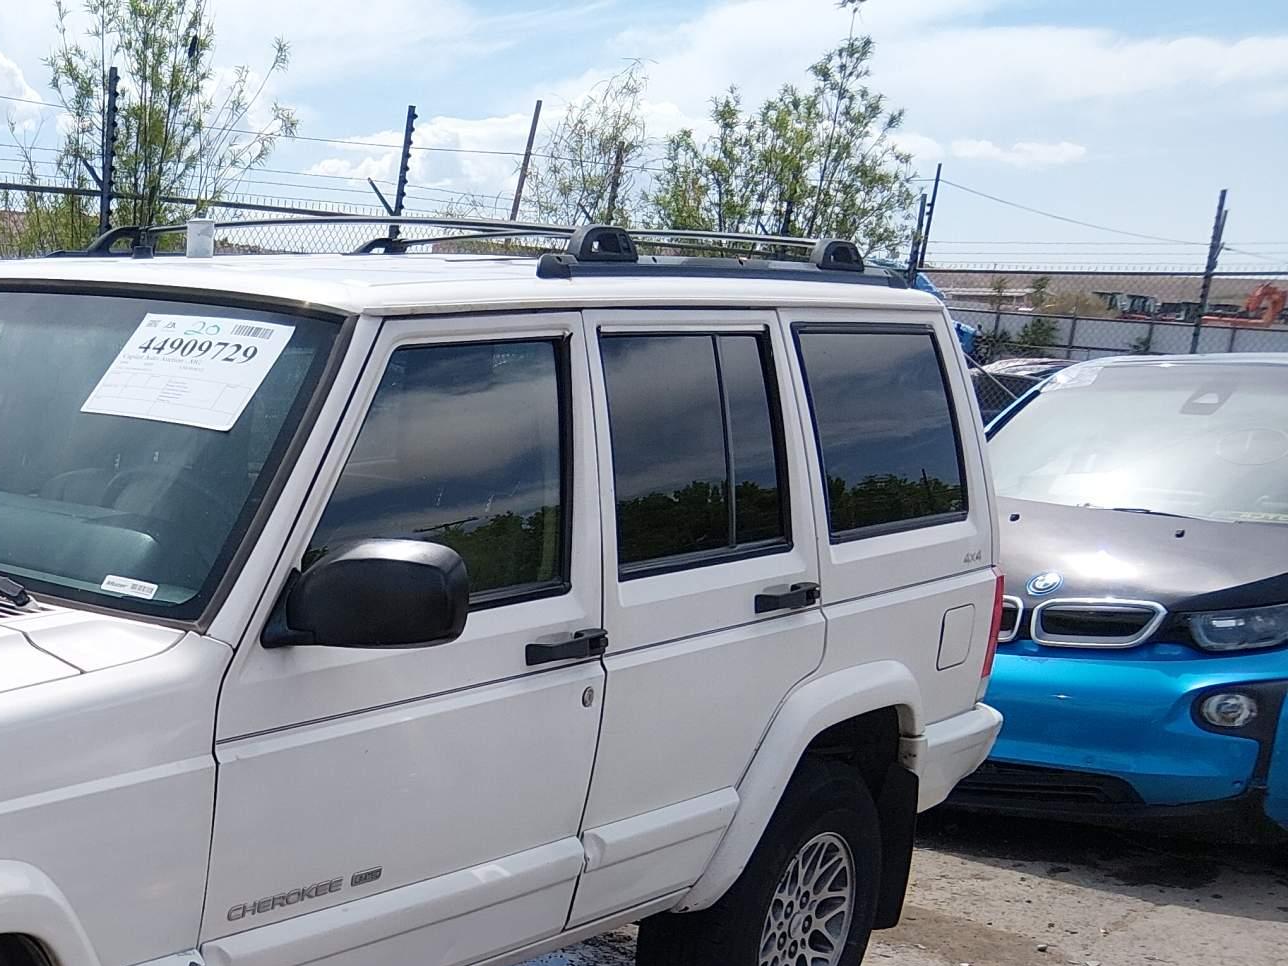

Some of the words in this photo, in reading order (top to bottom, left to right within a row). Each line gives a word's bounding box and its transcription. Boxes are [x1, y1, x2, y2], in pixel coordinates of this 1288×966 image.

[183, 320, 221, 336] 20
[138, 336, 258, 365] 44909729
[226, 876, 344, 922] CHEROKEE
